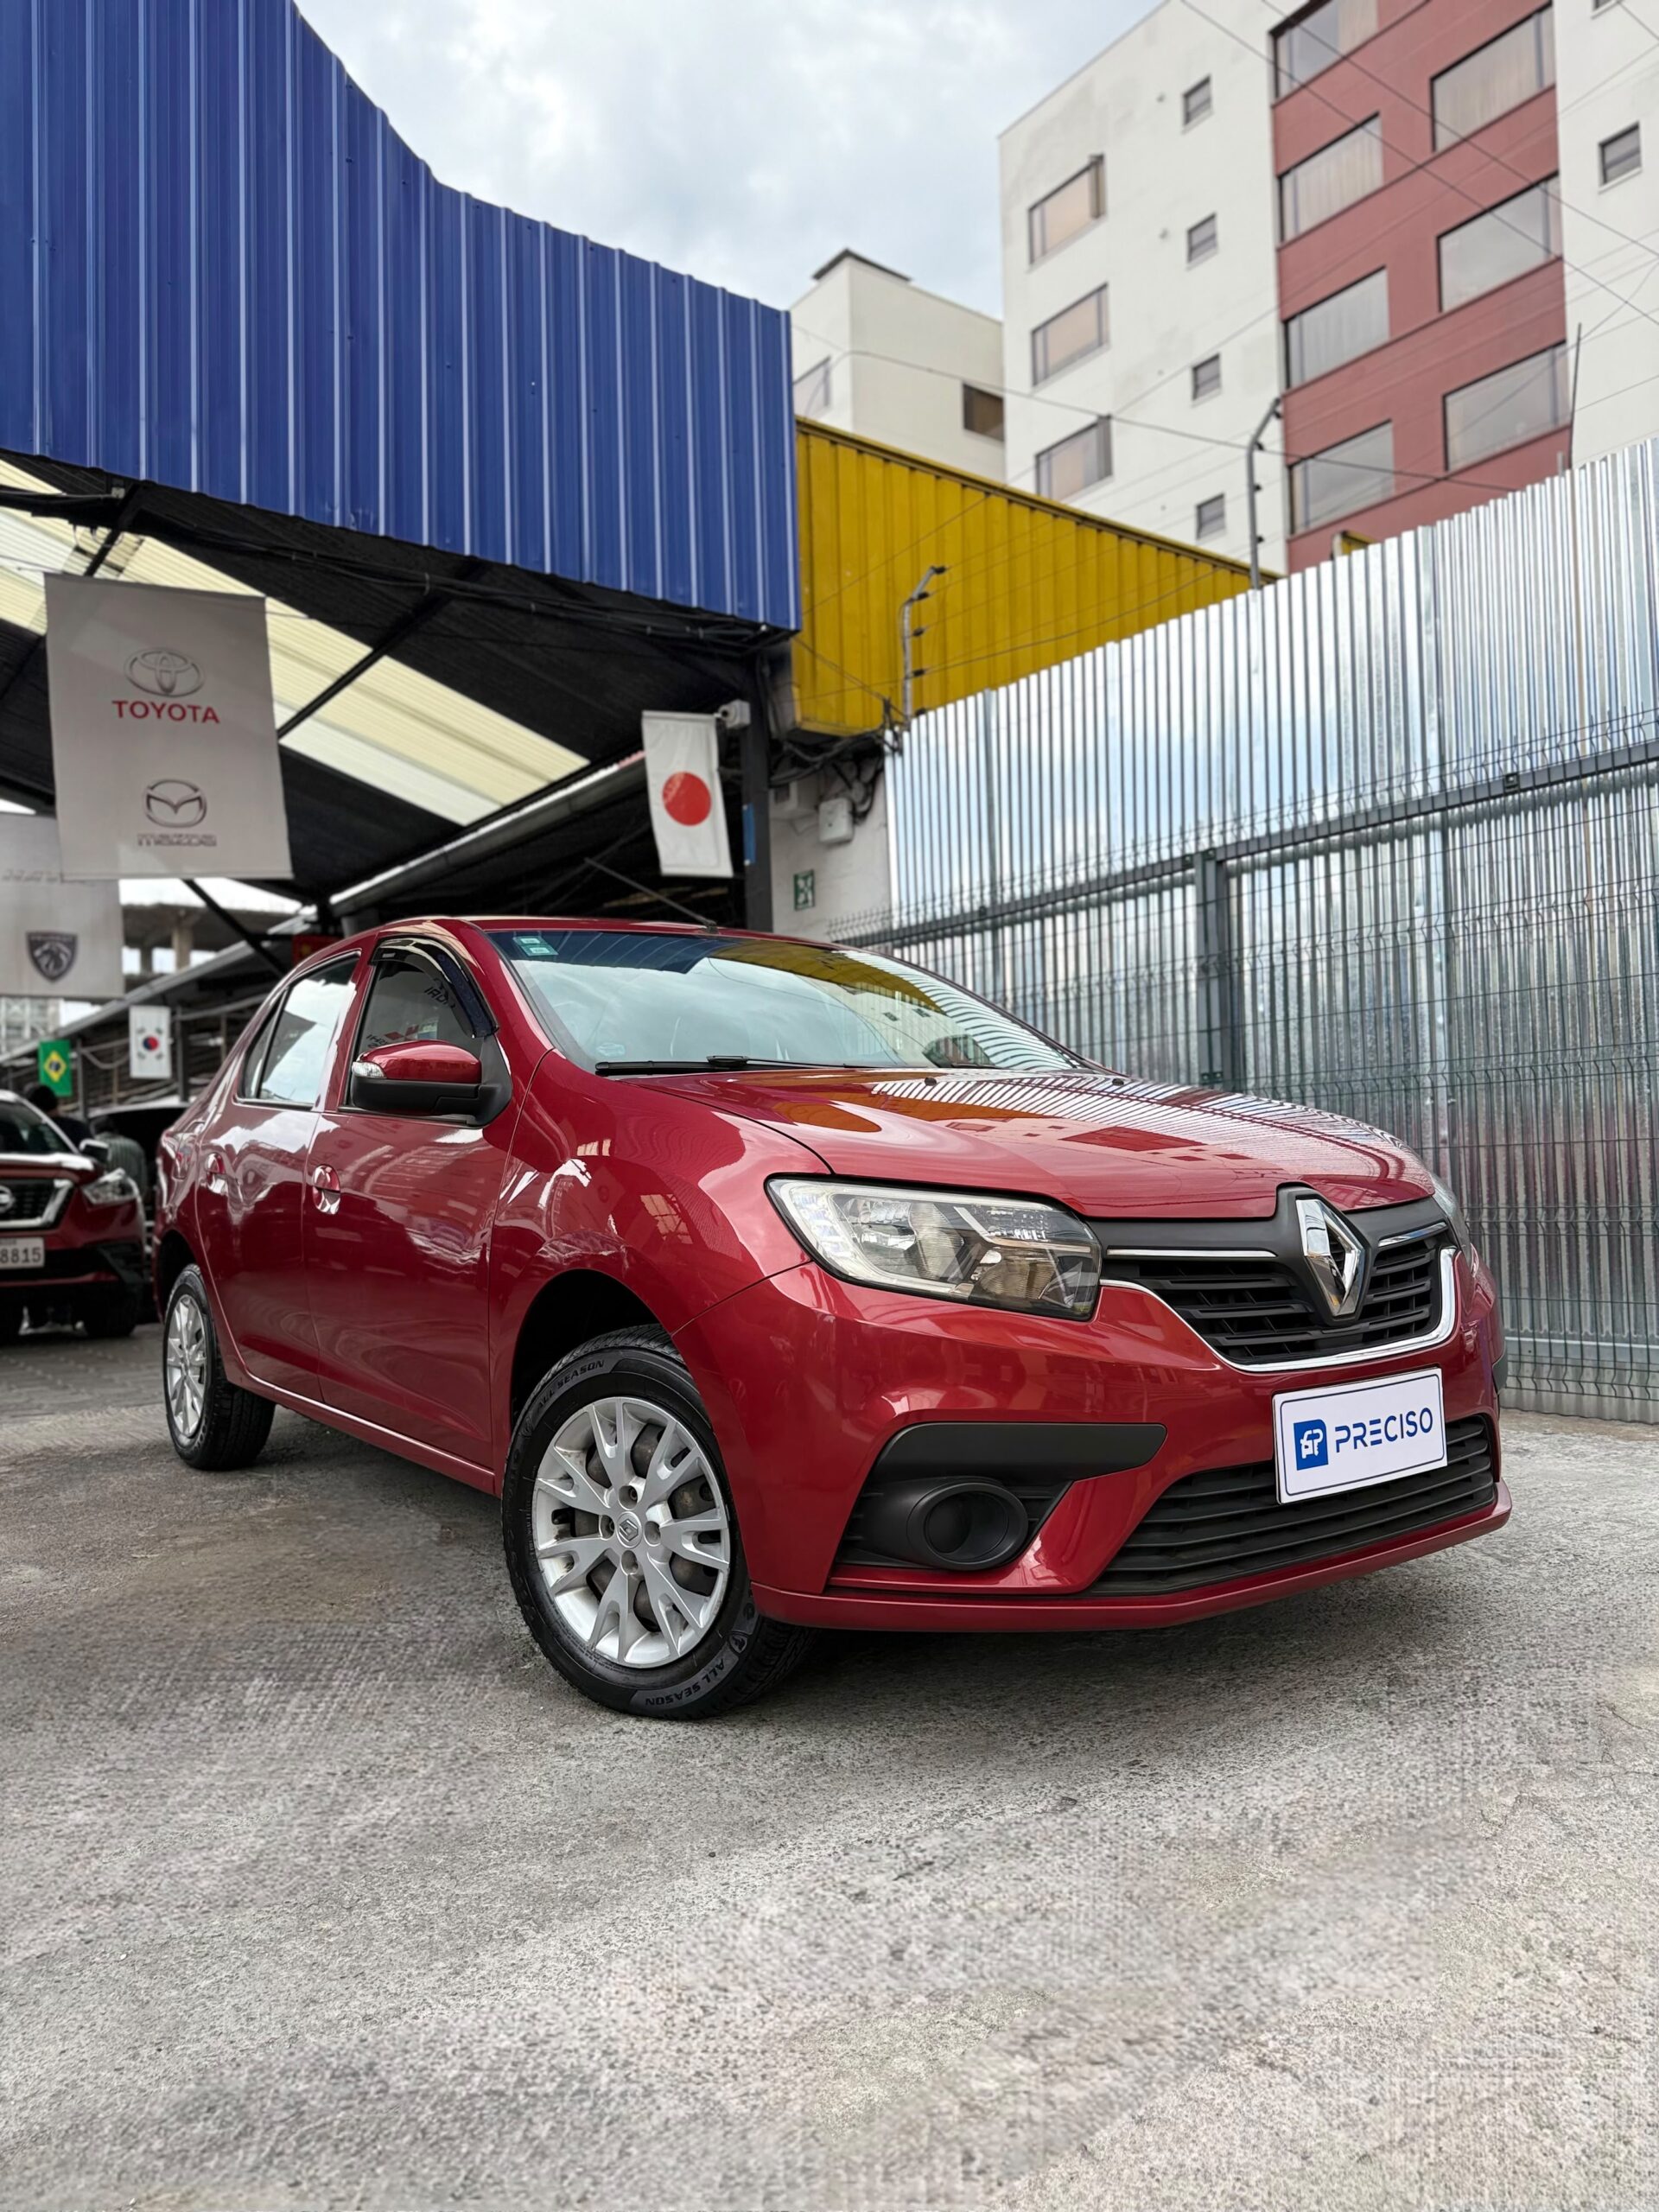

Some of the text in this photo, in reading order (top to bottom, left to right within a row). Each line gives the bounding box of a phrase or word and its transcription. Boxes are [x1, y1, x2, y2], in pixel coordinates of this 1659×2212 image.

[111, 700, 220, 724] TOYOTA
[556, 1360, 605, 1389] SEASON
[1335, 1408, 1433, 1453] PRECISO
[645, 1658, 725, 1705] ALL SEASON
